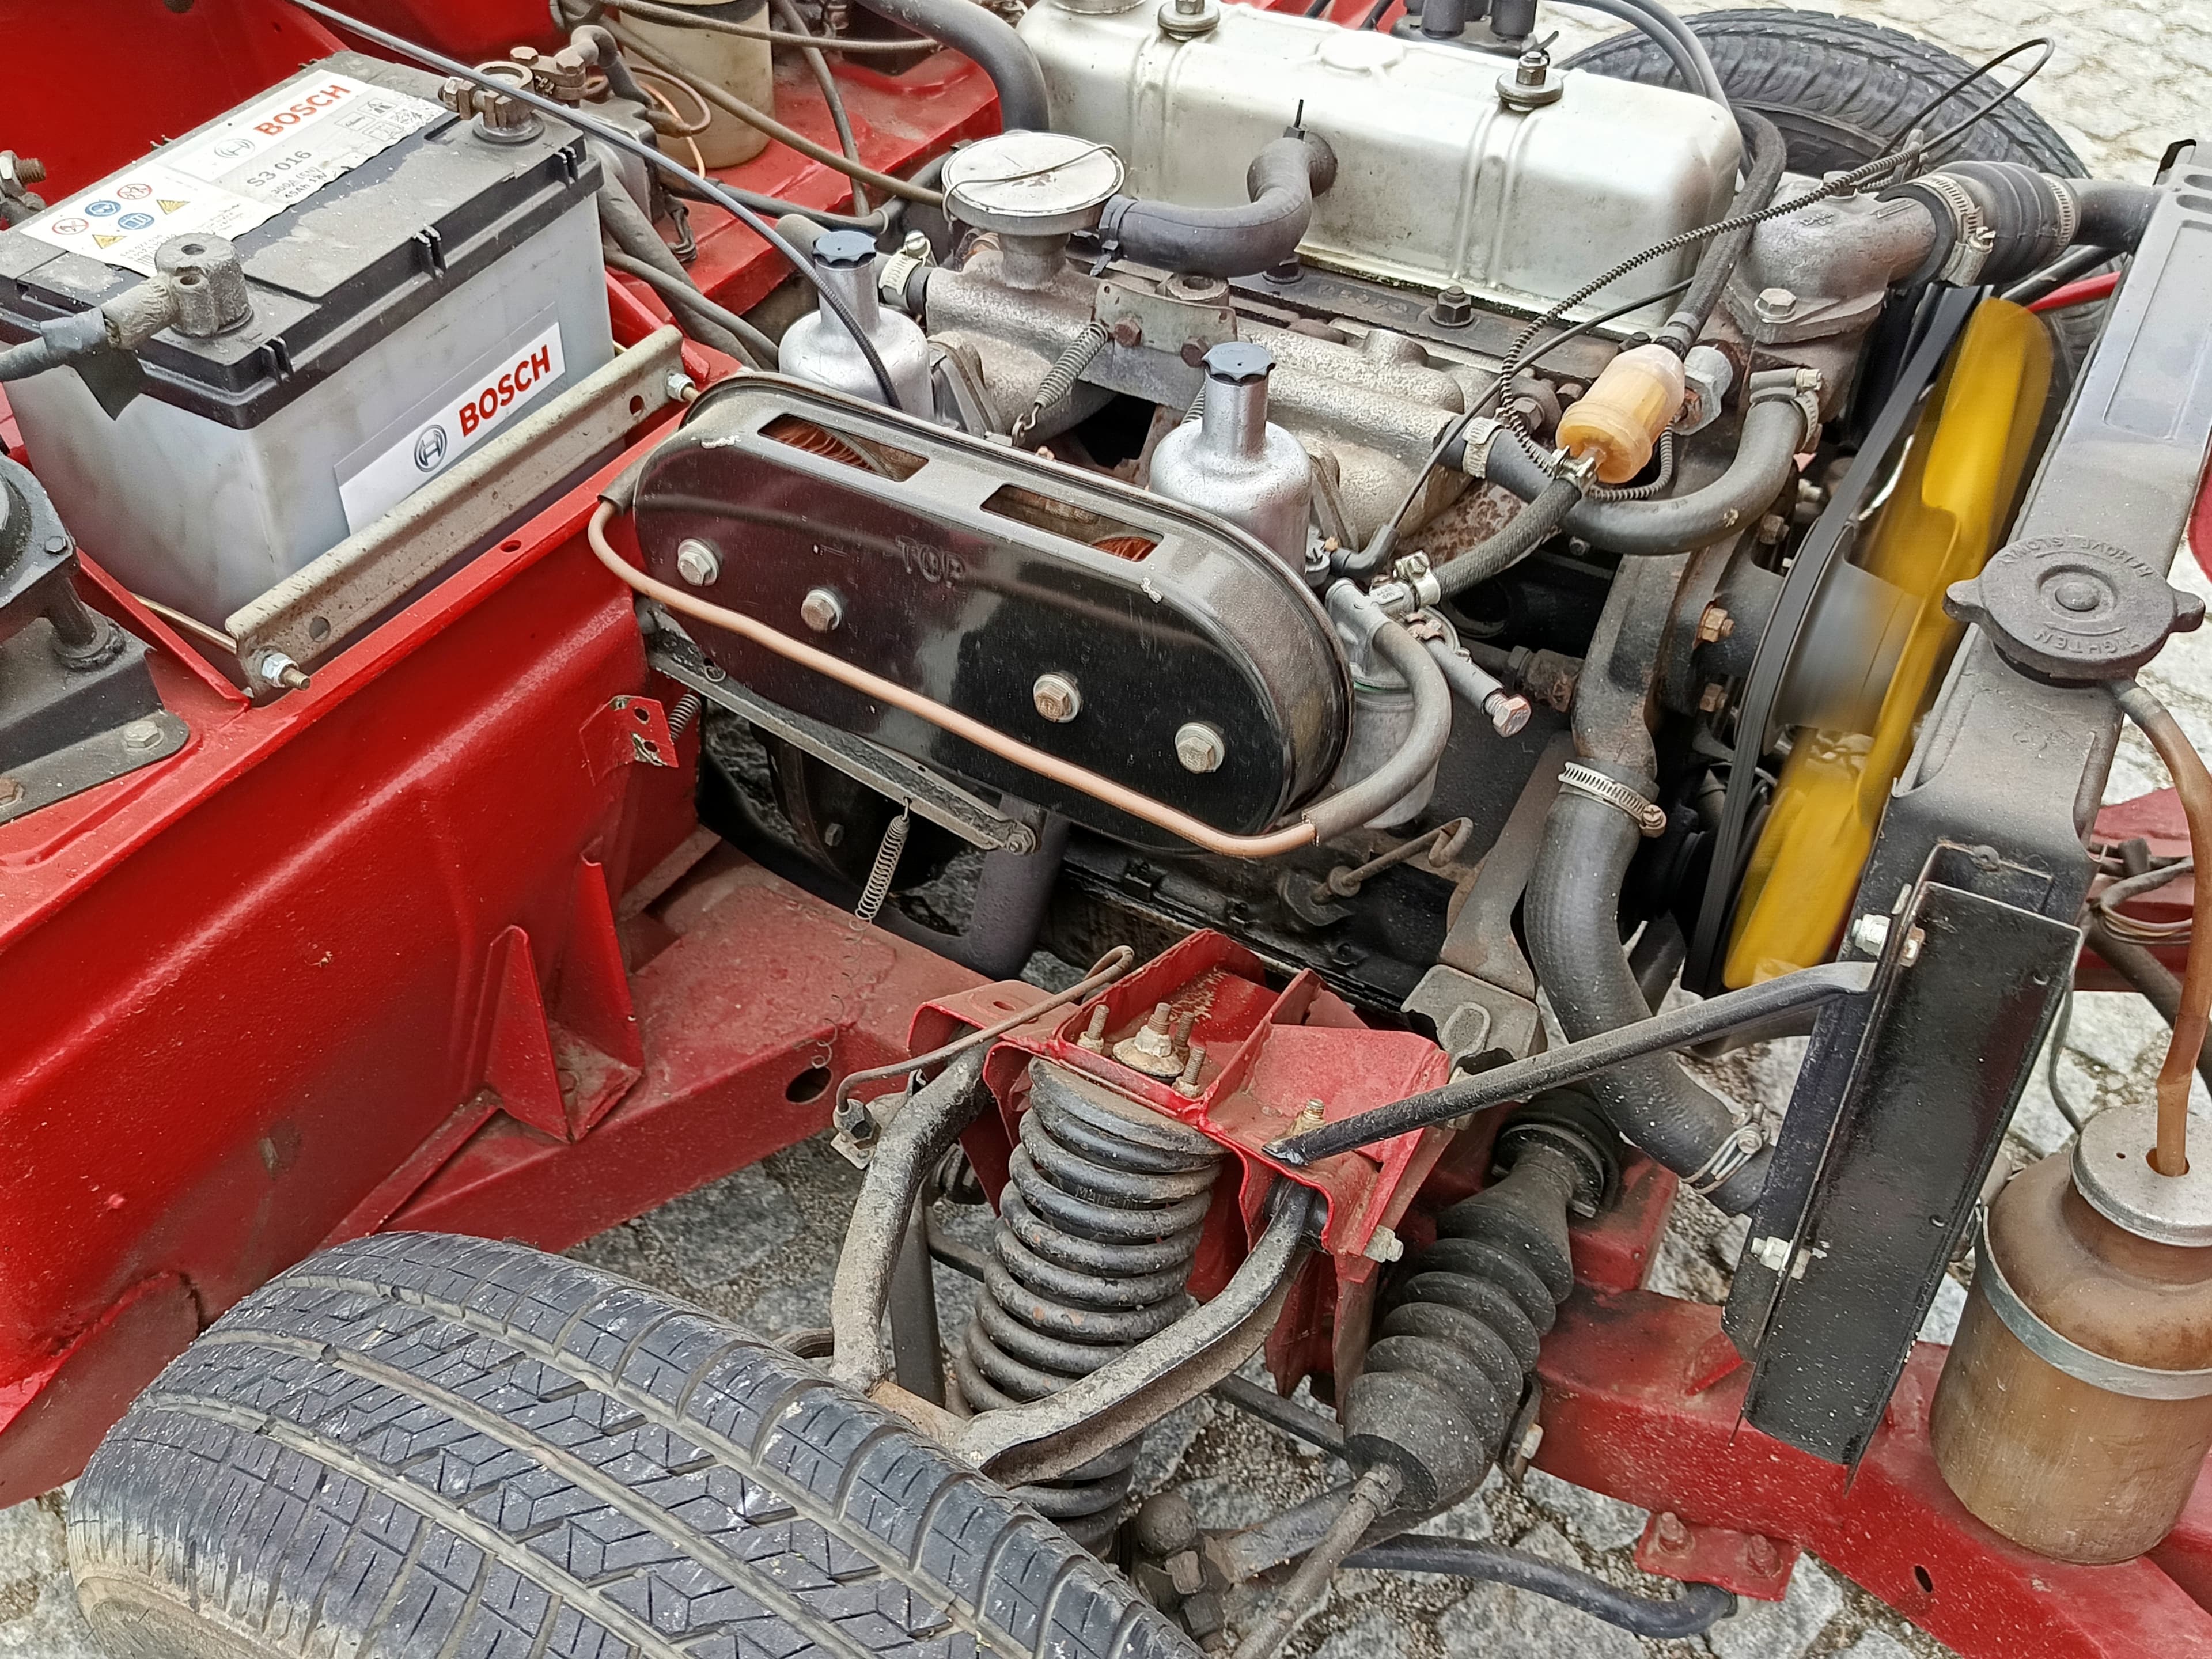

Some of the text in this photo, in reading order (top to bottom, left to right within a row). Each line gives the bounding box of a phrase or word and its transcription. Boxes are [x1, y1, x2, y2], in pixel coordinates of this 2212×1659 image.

[253, 84, 352, 137] BOSCH
[247, 150, 312, 187] S3 016
[459, 344, 551, 438] BOSCH
[895, 535, 966, 588] TOP
